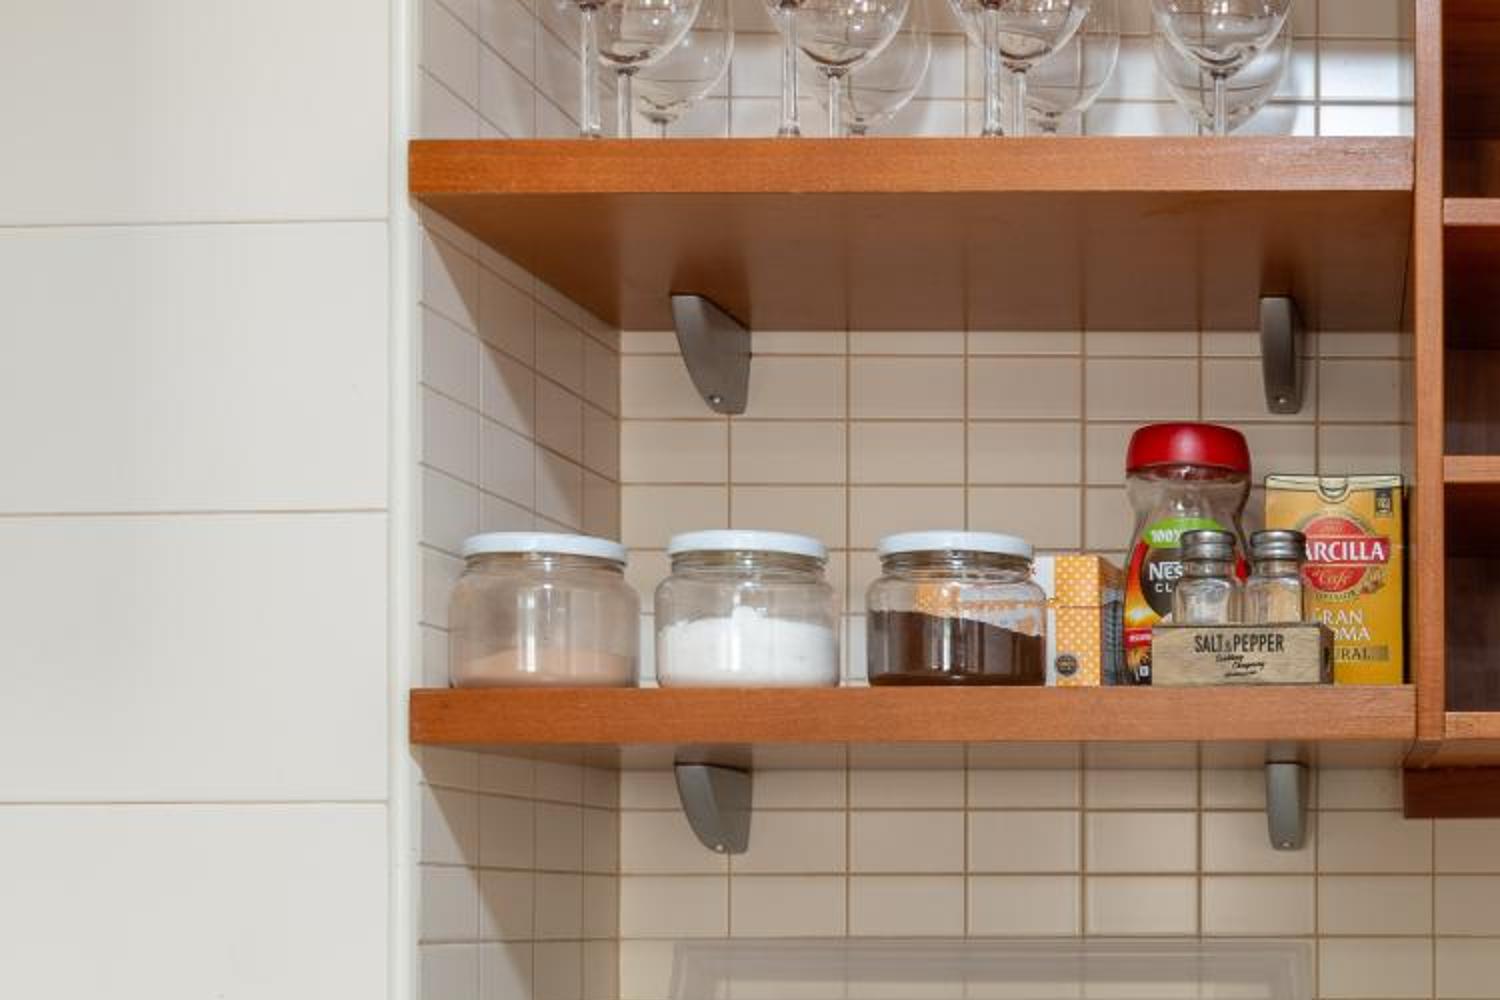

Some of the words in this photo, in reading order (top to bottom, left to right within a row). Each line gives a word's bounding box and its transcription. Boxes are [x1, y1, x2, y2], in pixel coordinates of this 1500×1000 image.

[1305, 541, 1384, 562] ARCILLA
[1149, 561, 1183, 581] NES
[1155, 583, 1173, 592] CL
[1322, 608, 1363, 625] RAN
[1194, 634, 1223, 652] SALT
[1233, 633, 1285, 653] PEPPER
